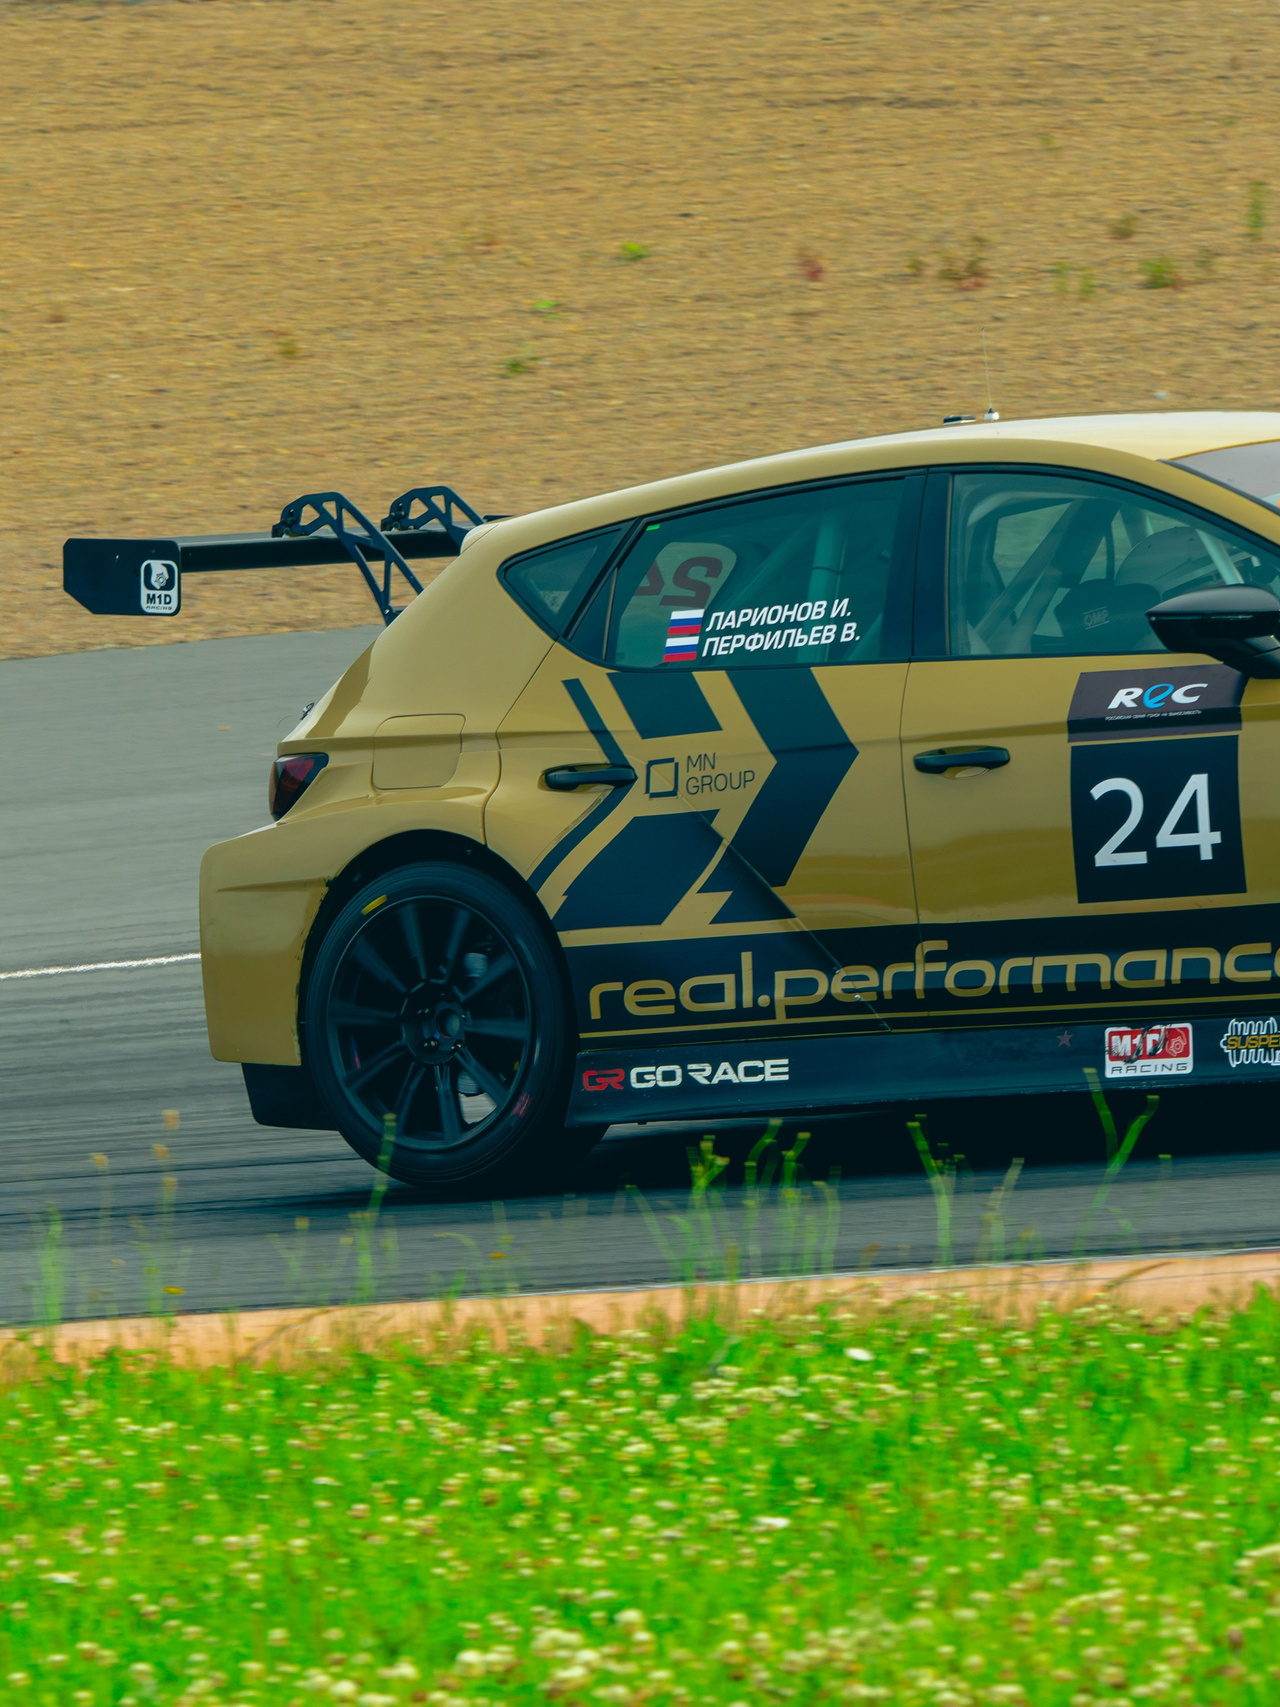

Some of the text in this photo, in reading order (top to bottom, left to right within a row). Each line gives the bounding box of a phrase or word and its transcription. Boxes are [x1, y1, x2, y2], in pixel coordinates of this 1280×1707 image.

[146, 593, 172, 605] M1D
[705, 598, 851, 632] ЛАРИОНОВ И.
[702, 622, 861, 657] ПЕРФИЛЬЕВ В.
[686, 752, 716, 773] MN
[686, 770, 755, 795] GROUP
[1090, 773, 1222, 867] 24
[582, 1058, 790, 1091] GR GO RACE
[1111, 1062, 1188, 1075] RACING
